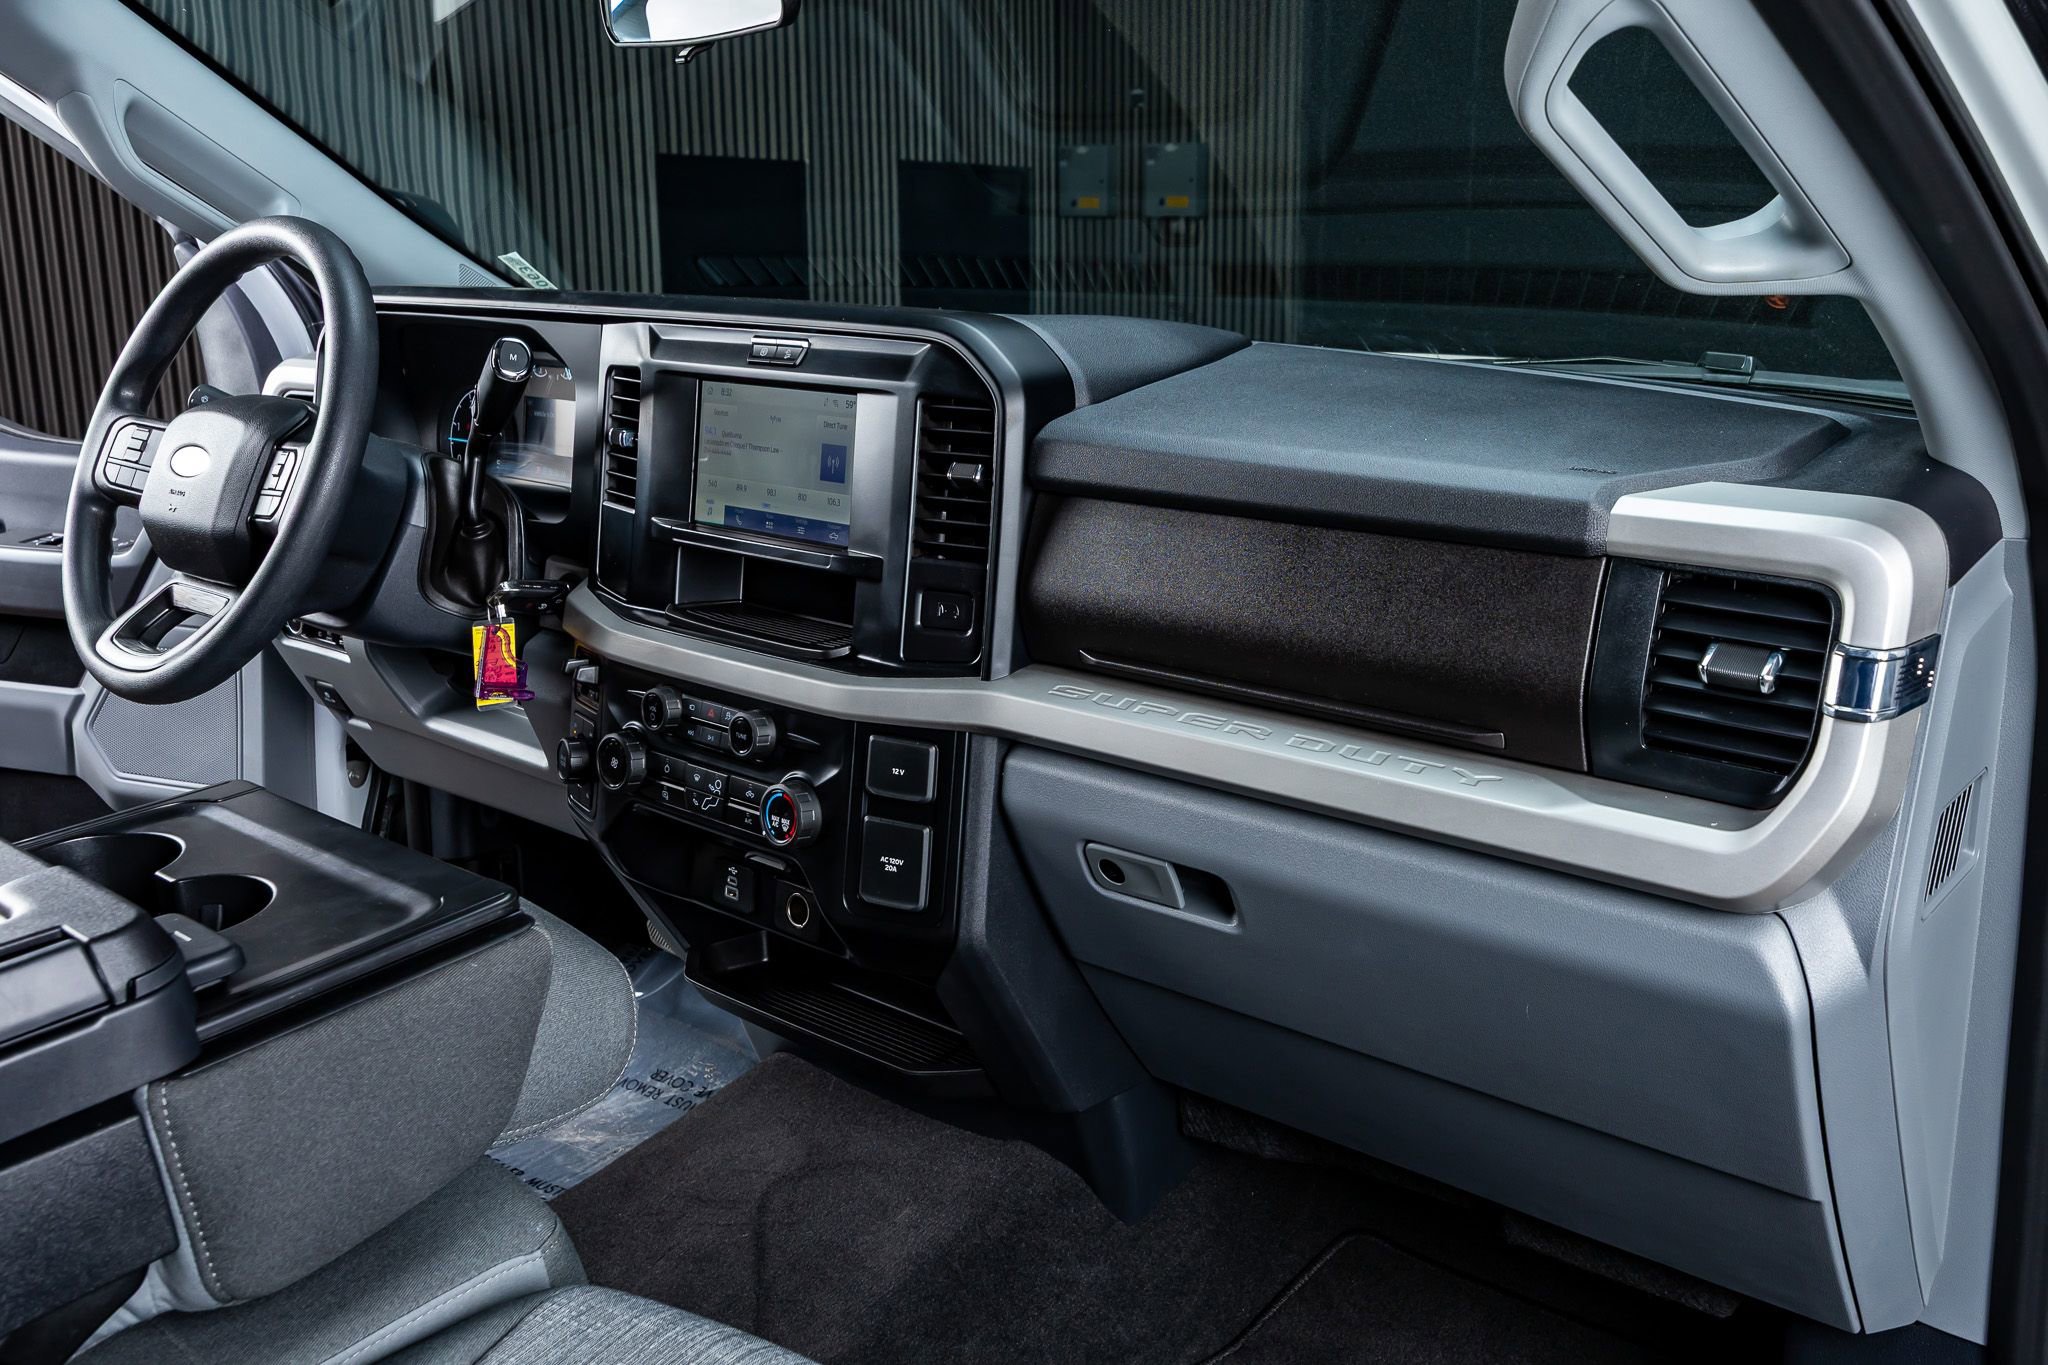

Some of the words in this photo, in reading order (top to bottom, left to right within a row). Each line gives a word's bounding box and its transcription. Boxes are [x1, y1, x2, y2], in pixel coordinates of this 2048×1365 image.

[509, 353, 517, 361] M
[735, 732, 748, 740] TUNE
[1047, 683, 1274, 741] SUPER
[1284, 732, 1504, 787] DUTY
[889, 857, 904, 866] 120V
[884, 864, 897, 873] 20A
[650, 1068, 694, 1093] COVER
